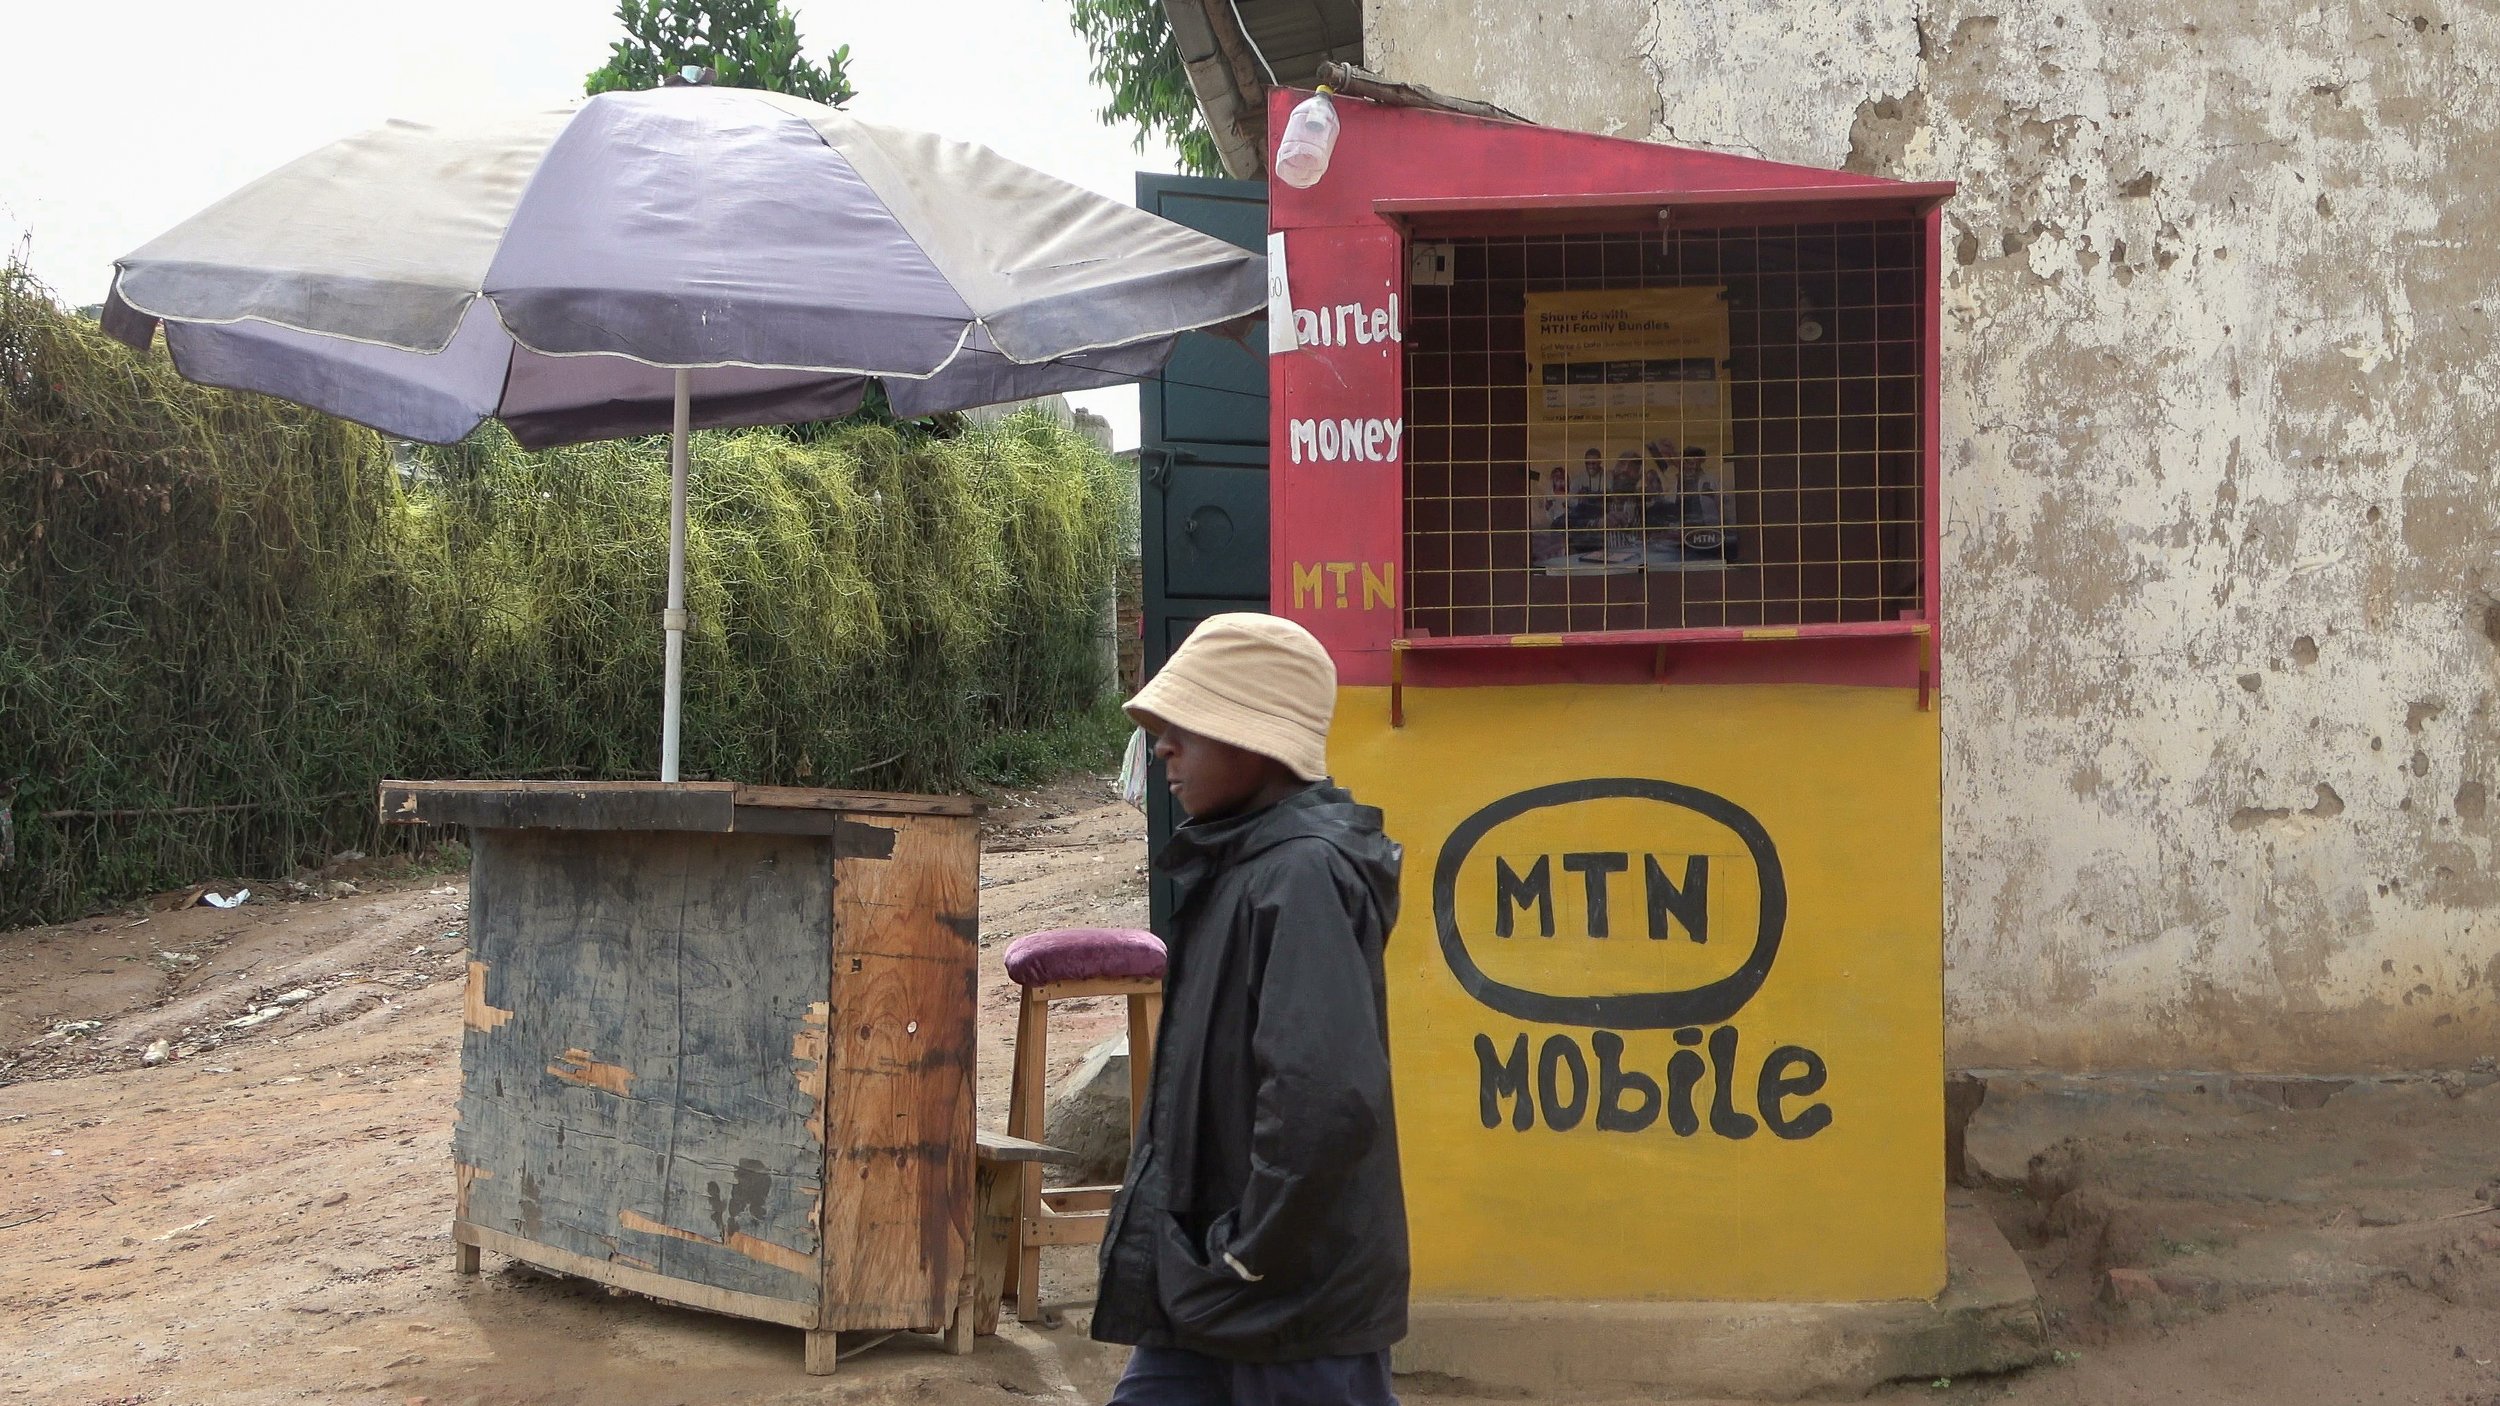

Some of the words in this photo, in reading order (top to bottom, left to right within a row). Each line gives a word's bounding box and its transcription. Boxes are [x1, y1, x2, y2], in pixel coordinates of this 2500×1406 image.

[1292, 292, 1401, 346] airtel
[1541, 323, 1569, 334] MTN
[1573, 321, 1615, 334] Family
[1618, 319, 1670, 331] Bundles
[1693, 533, 1715, 544] MTN
[1293, 561, 1396, 611] MTN
[1495, 852, 1709, 944] MTN
